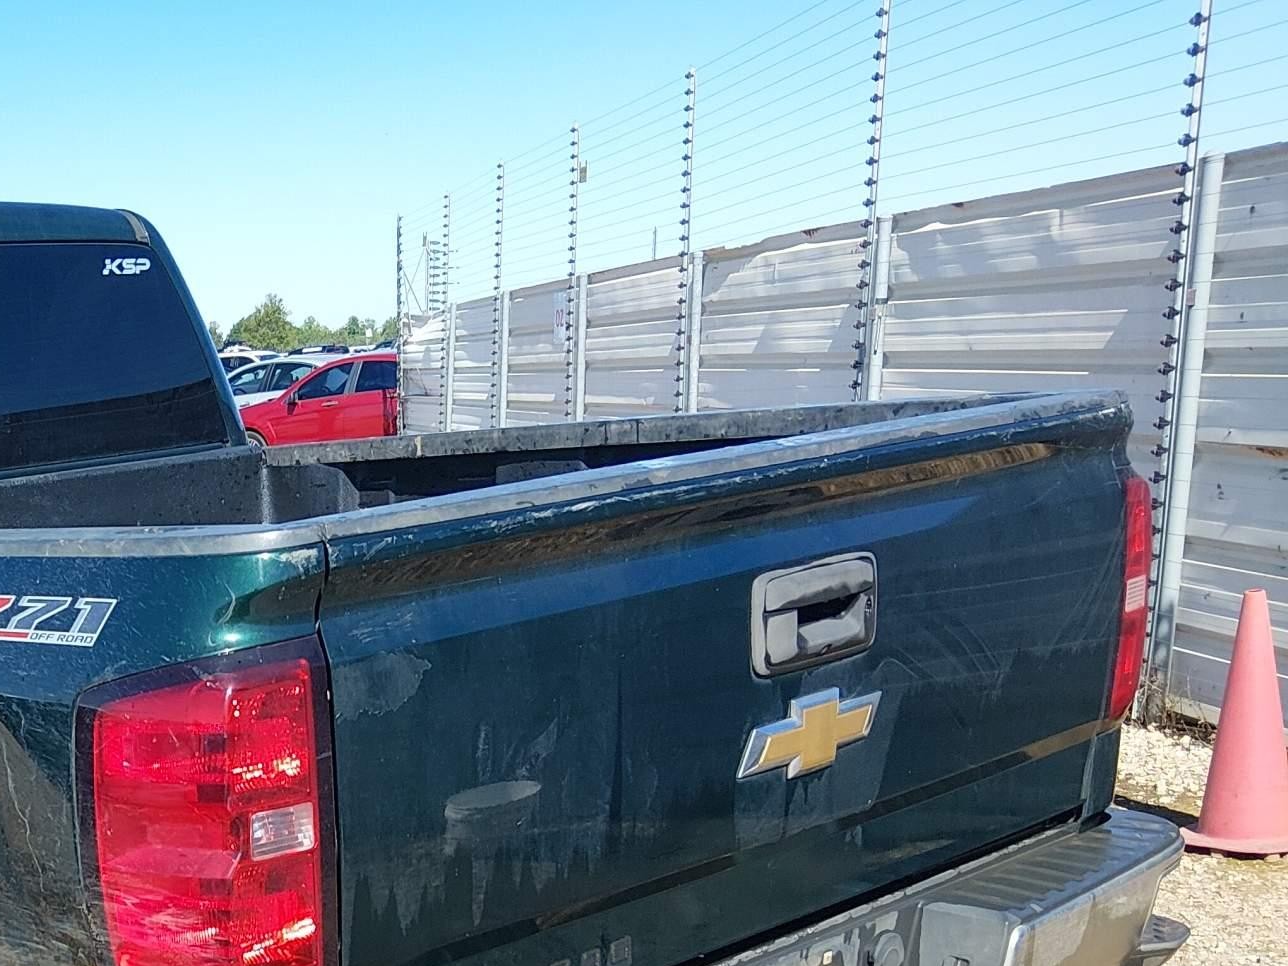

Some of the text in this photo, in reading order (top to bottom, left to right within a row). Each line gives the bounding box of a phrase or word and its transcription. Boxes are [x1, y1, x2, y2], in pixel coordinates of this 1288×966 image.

[102, 257, 151, 276] KSP
[29, 632, 94, 645] OFF ROAD
